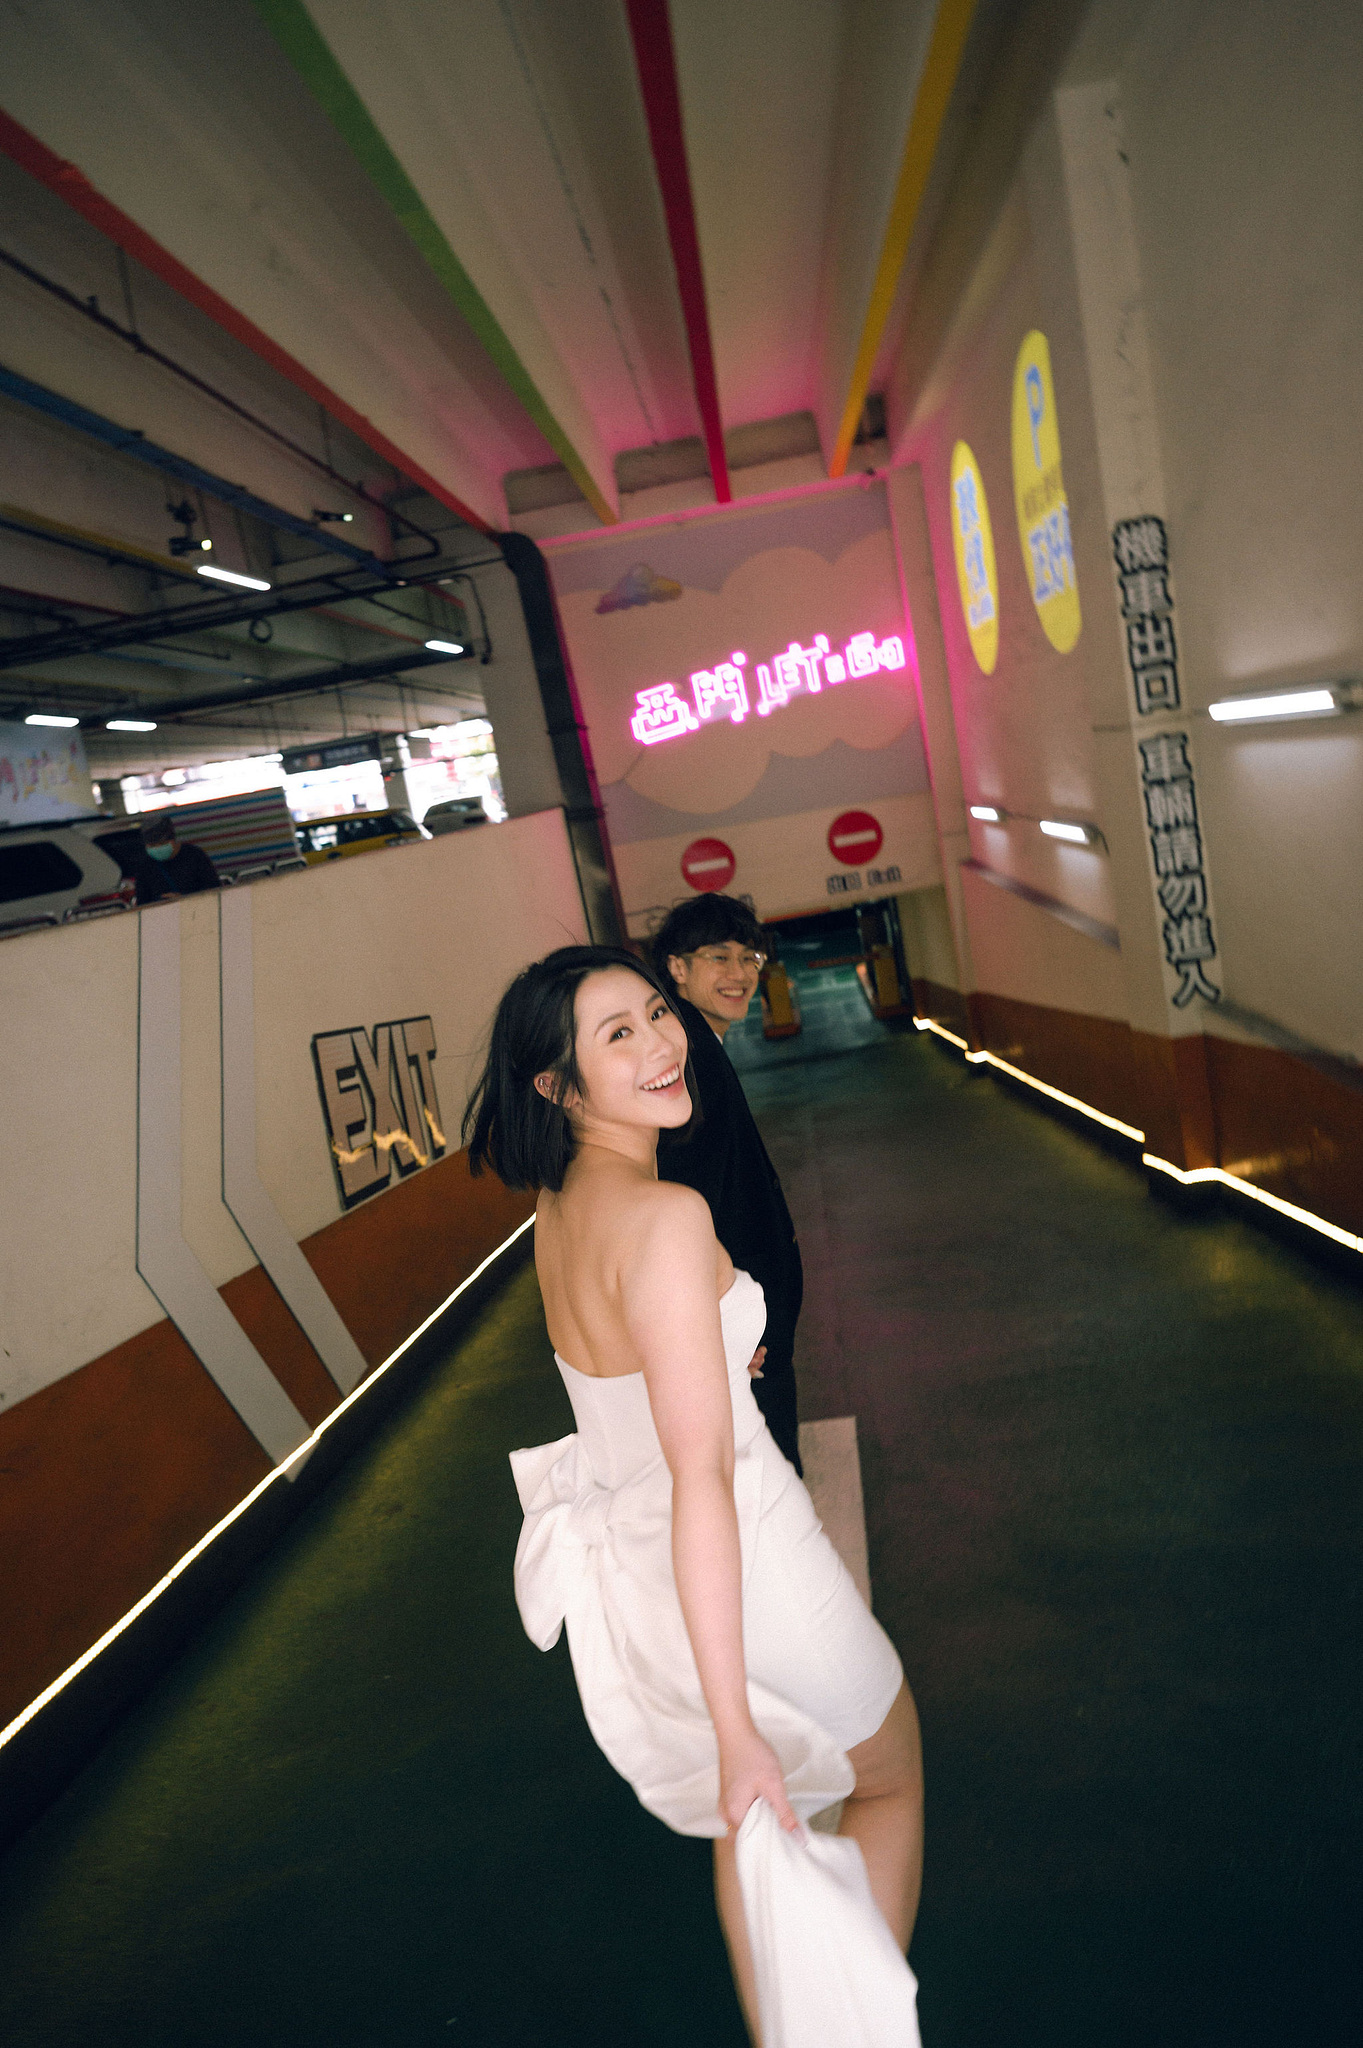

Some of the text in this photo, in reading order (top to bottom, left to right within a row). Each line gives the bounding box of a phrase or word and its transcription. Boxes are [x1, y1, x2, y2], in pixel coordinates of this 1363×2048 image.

[1024, 362, 1046, 470] P
[1112, 514, 1221, 1008] 機車出口 車輛請勿進入
[311, 1015, 446, 1211] EXIT
